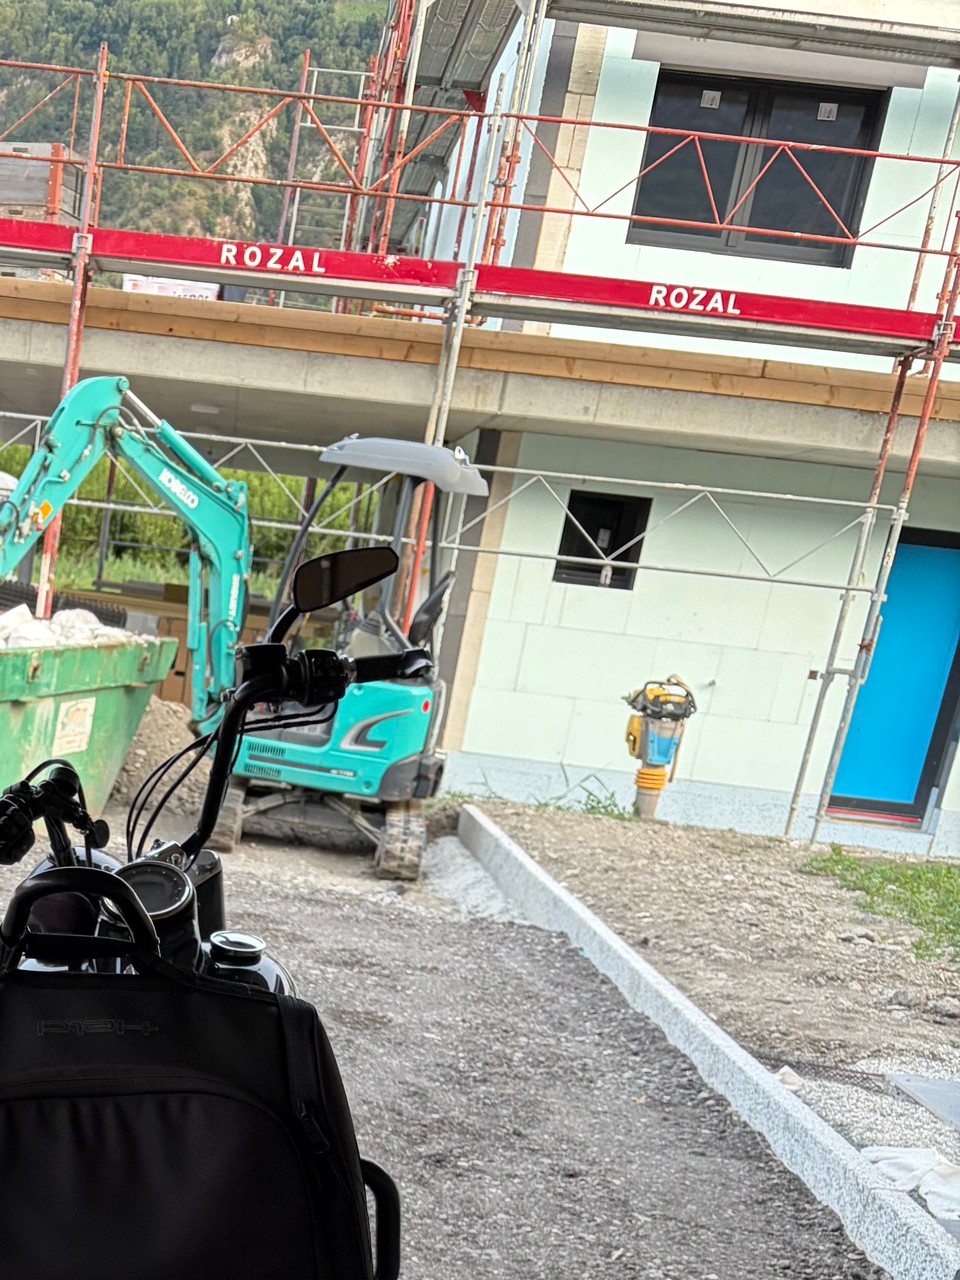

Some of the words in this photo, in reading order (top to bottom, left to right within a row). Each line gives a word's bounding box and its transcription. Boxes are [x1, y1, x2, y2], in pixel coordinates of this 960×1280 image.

[220, 243, 327, 274] ROZAL
[648, 284, 742, 315] ROZAL
[158, 468, 199, 509] KOBELCO
